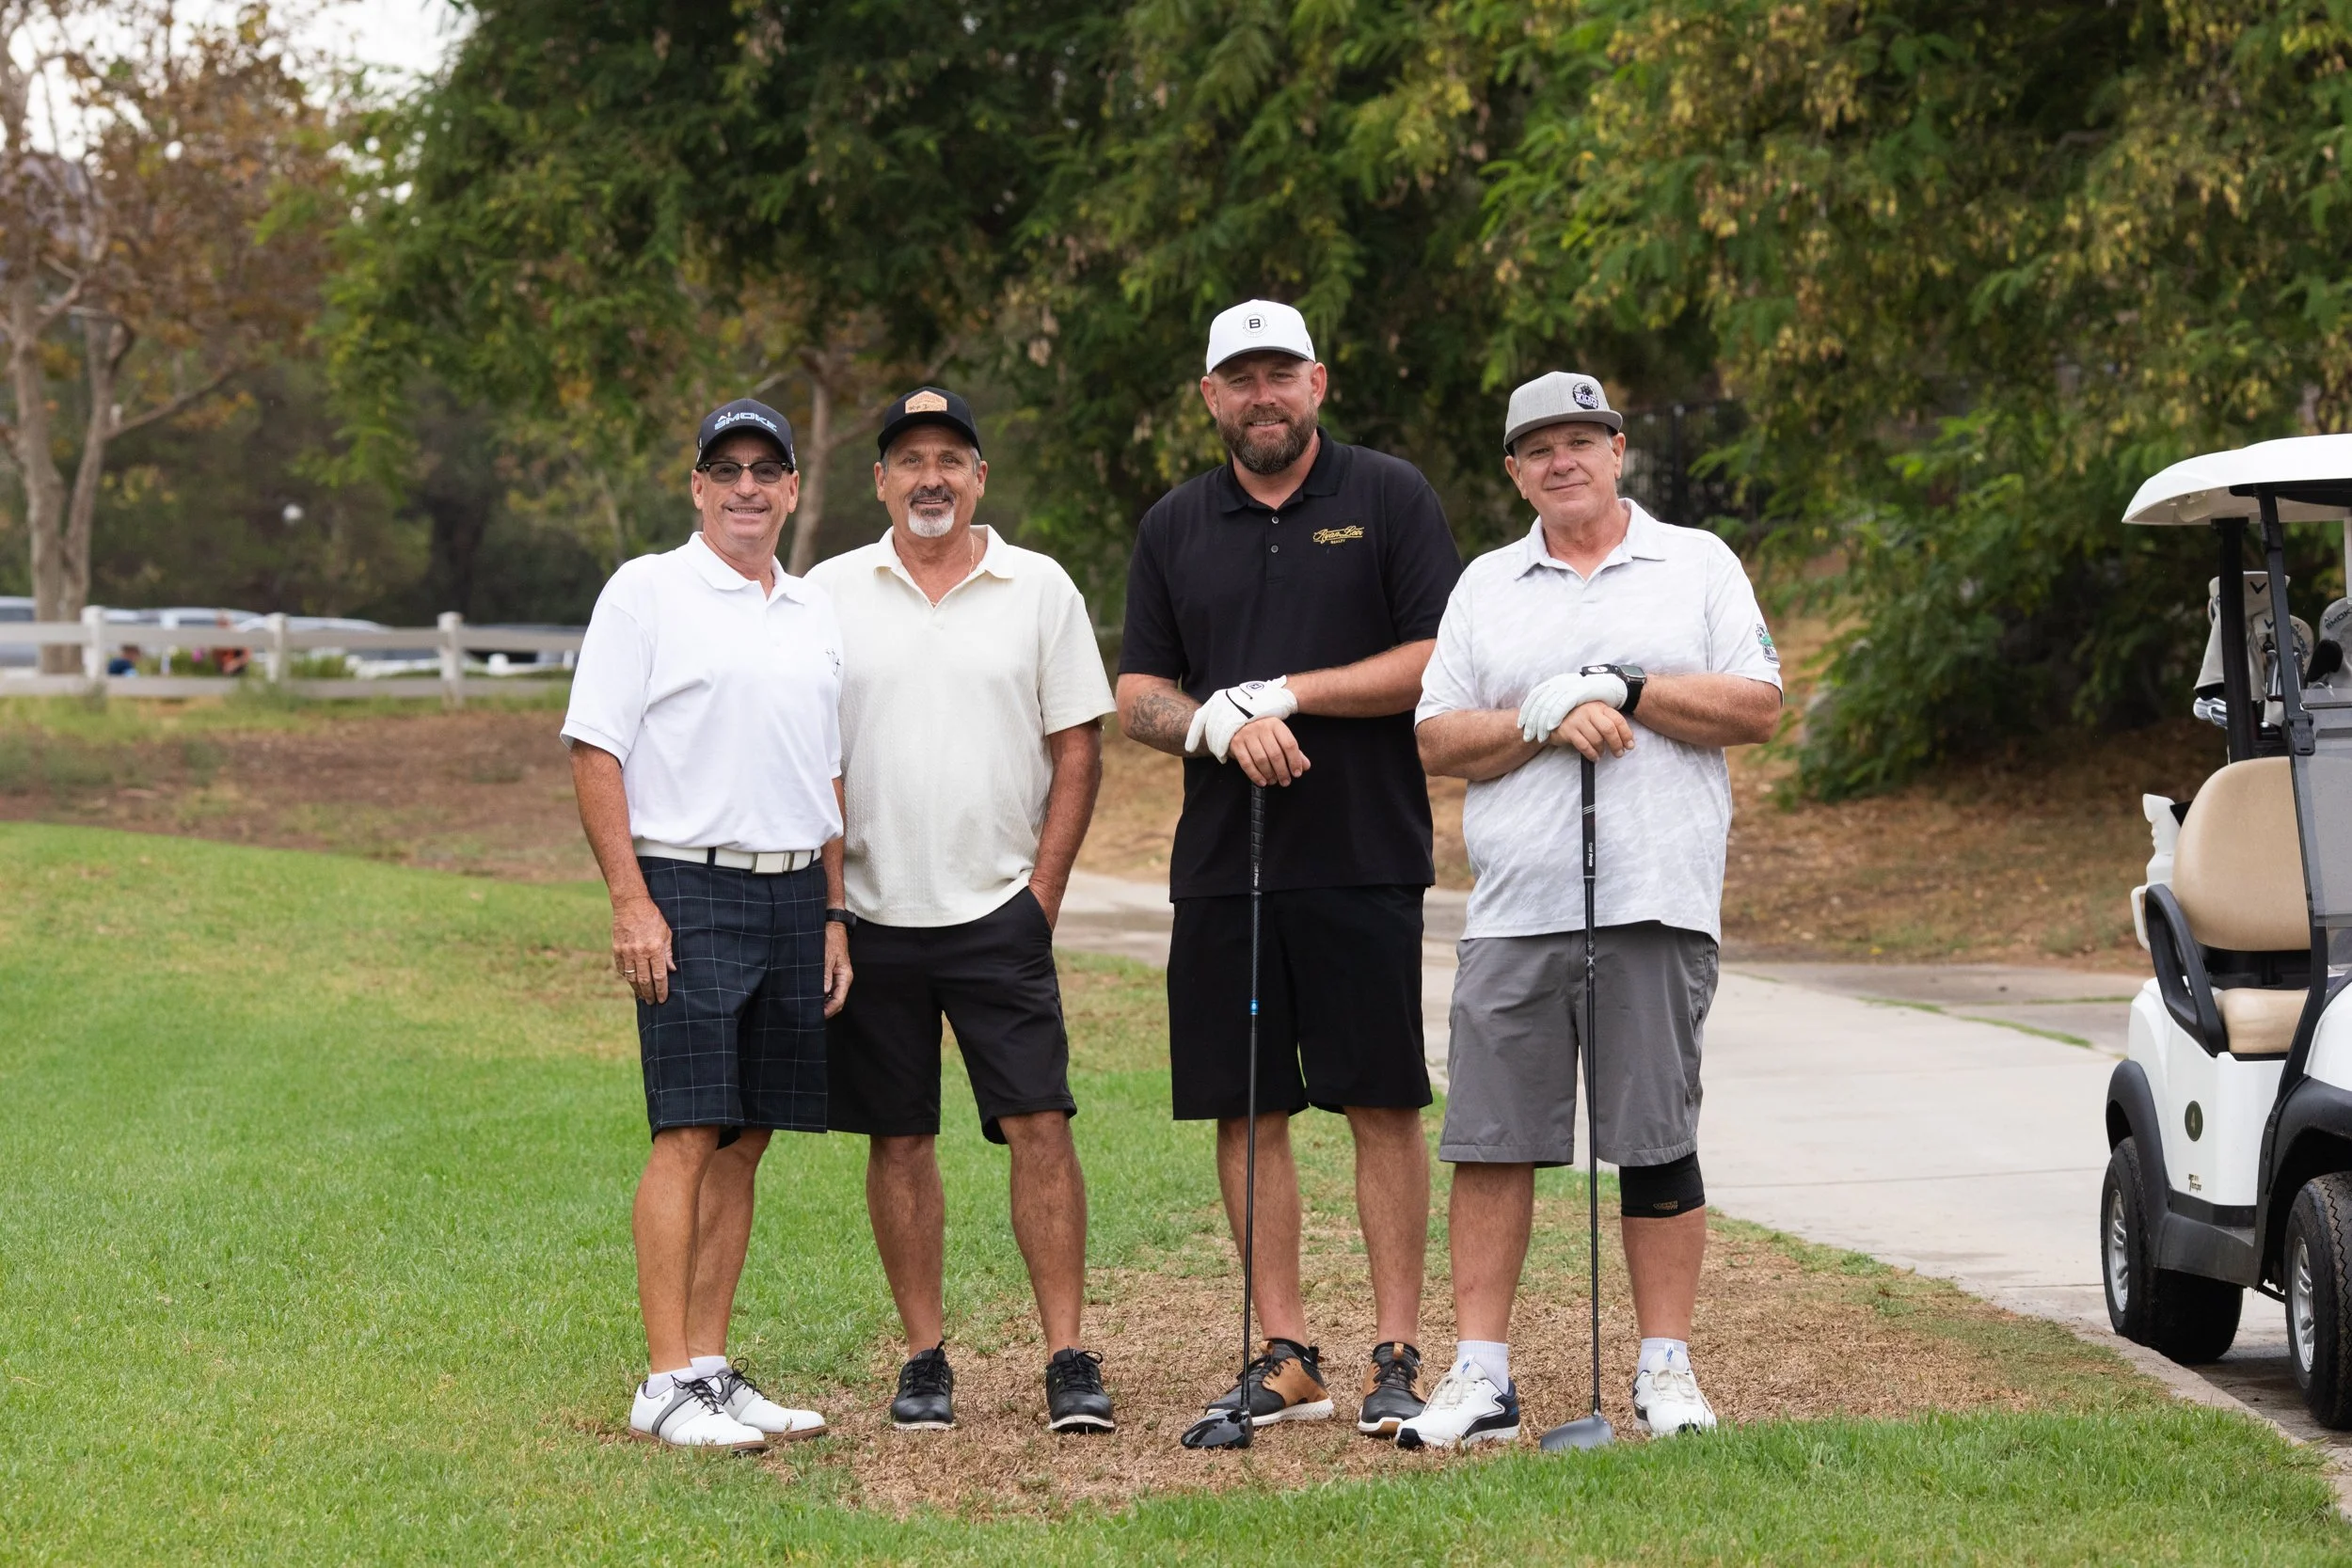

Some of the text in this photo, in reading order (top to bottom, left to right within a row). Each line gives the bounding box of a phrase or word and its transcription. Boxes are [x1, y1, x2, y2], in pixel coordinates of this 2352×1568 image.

[1249, 318, 1262, 329] B
[714, 412, 777, 433] SMOKE
[2325, 608, 2352, 630] SMOK
